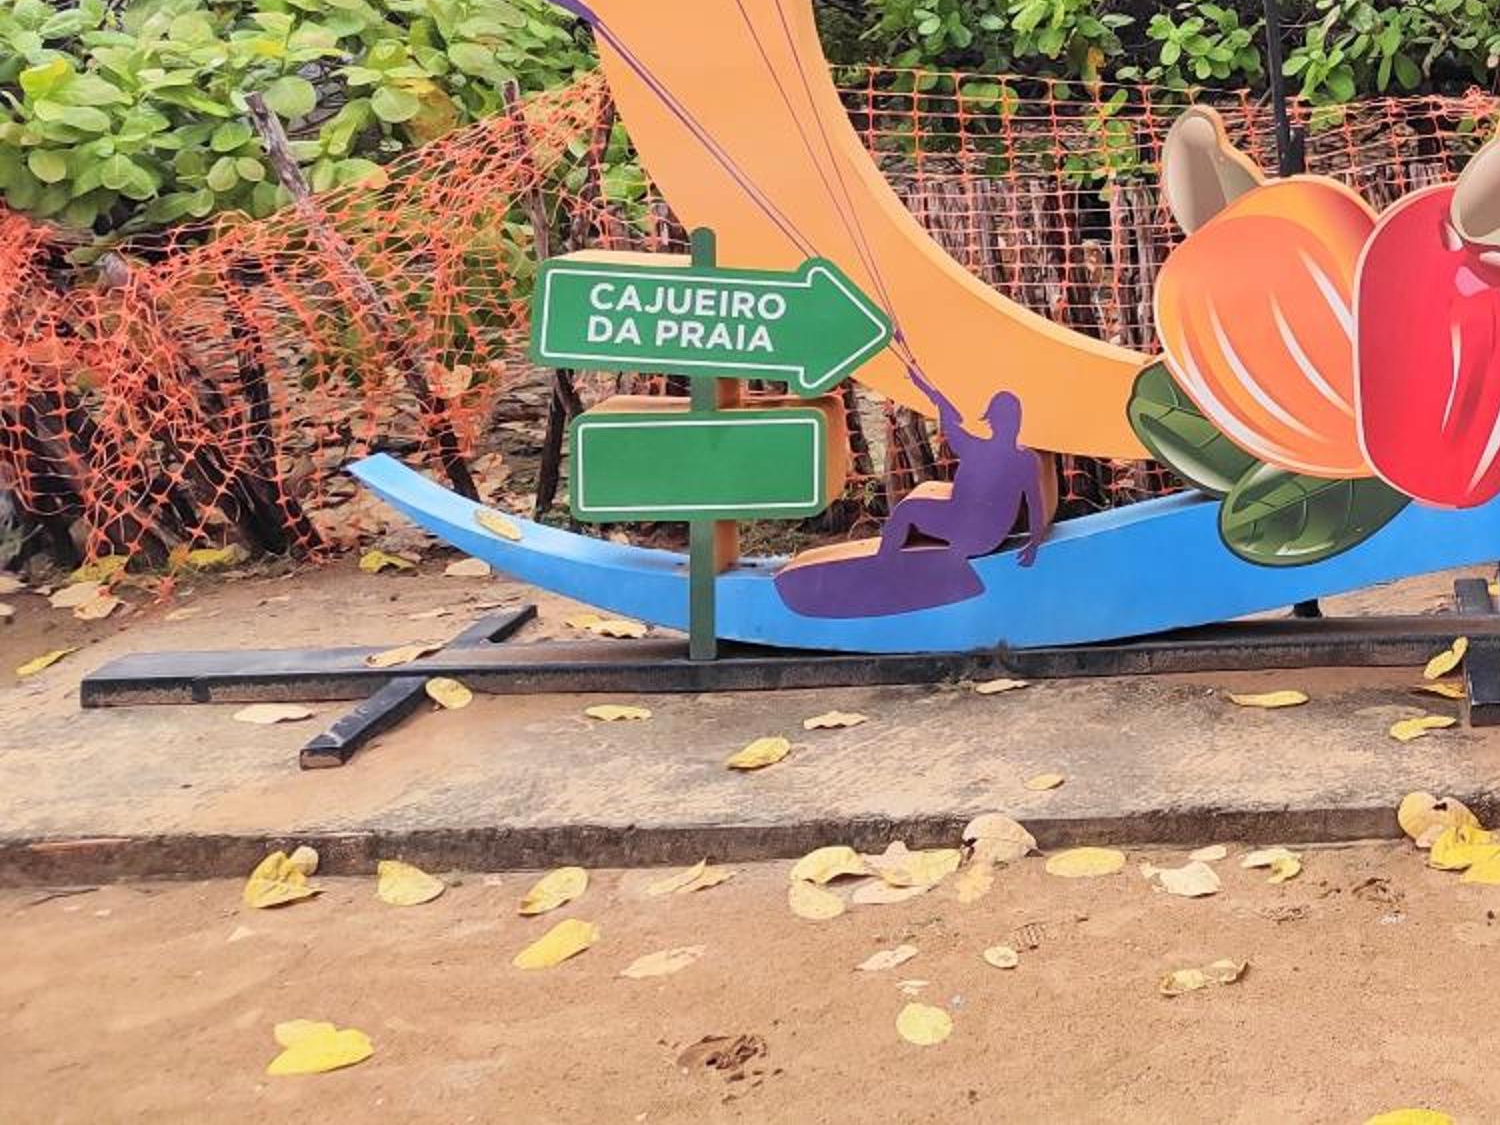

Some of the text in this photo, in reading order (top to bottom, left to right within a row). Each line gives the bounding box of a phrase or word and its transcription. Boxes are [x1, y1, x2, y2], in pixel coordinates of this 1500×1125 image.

[590, 283, 787, 321] CAJUEIRO
[587, 316, 774, 353] DA PRAIA
